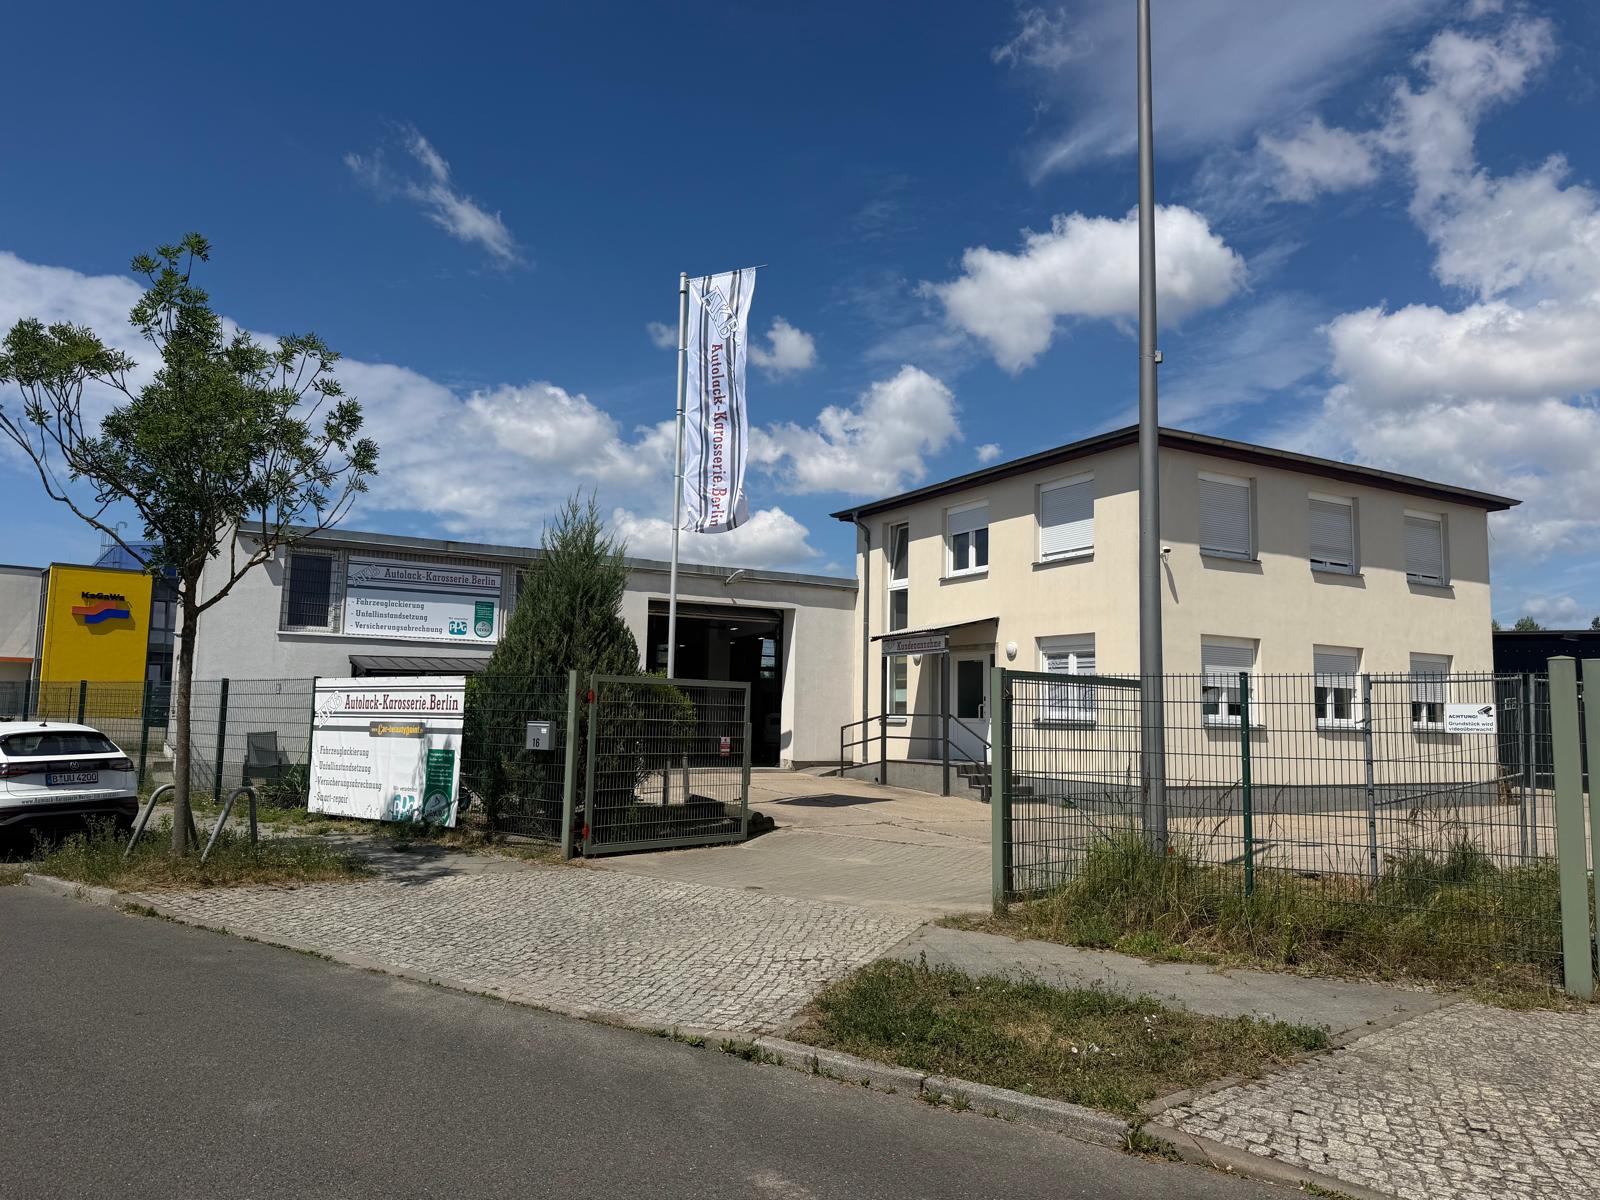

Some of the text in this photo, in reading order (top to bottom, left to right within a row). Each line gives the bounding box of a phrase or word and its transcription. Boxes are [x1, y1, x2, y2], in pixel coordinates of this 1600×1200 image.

[709, 343, 729, 528] Autolack-Karosserie.Berlin
[384, 568, 496, 586] Autolack-Karosserie.Berlin
[356, 598, 425, 610] Fahrzeuglackierung
[355, 610, 428, 622] Unfallinstandsetzung
[449, 621, 467, 634] PPG
[344, 694, 458, 711] Autolack-Karosserie.Berlin
[532, 738, 540, 747] 16
[77, 773, 96, 782] 4200
